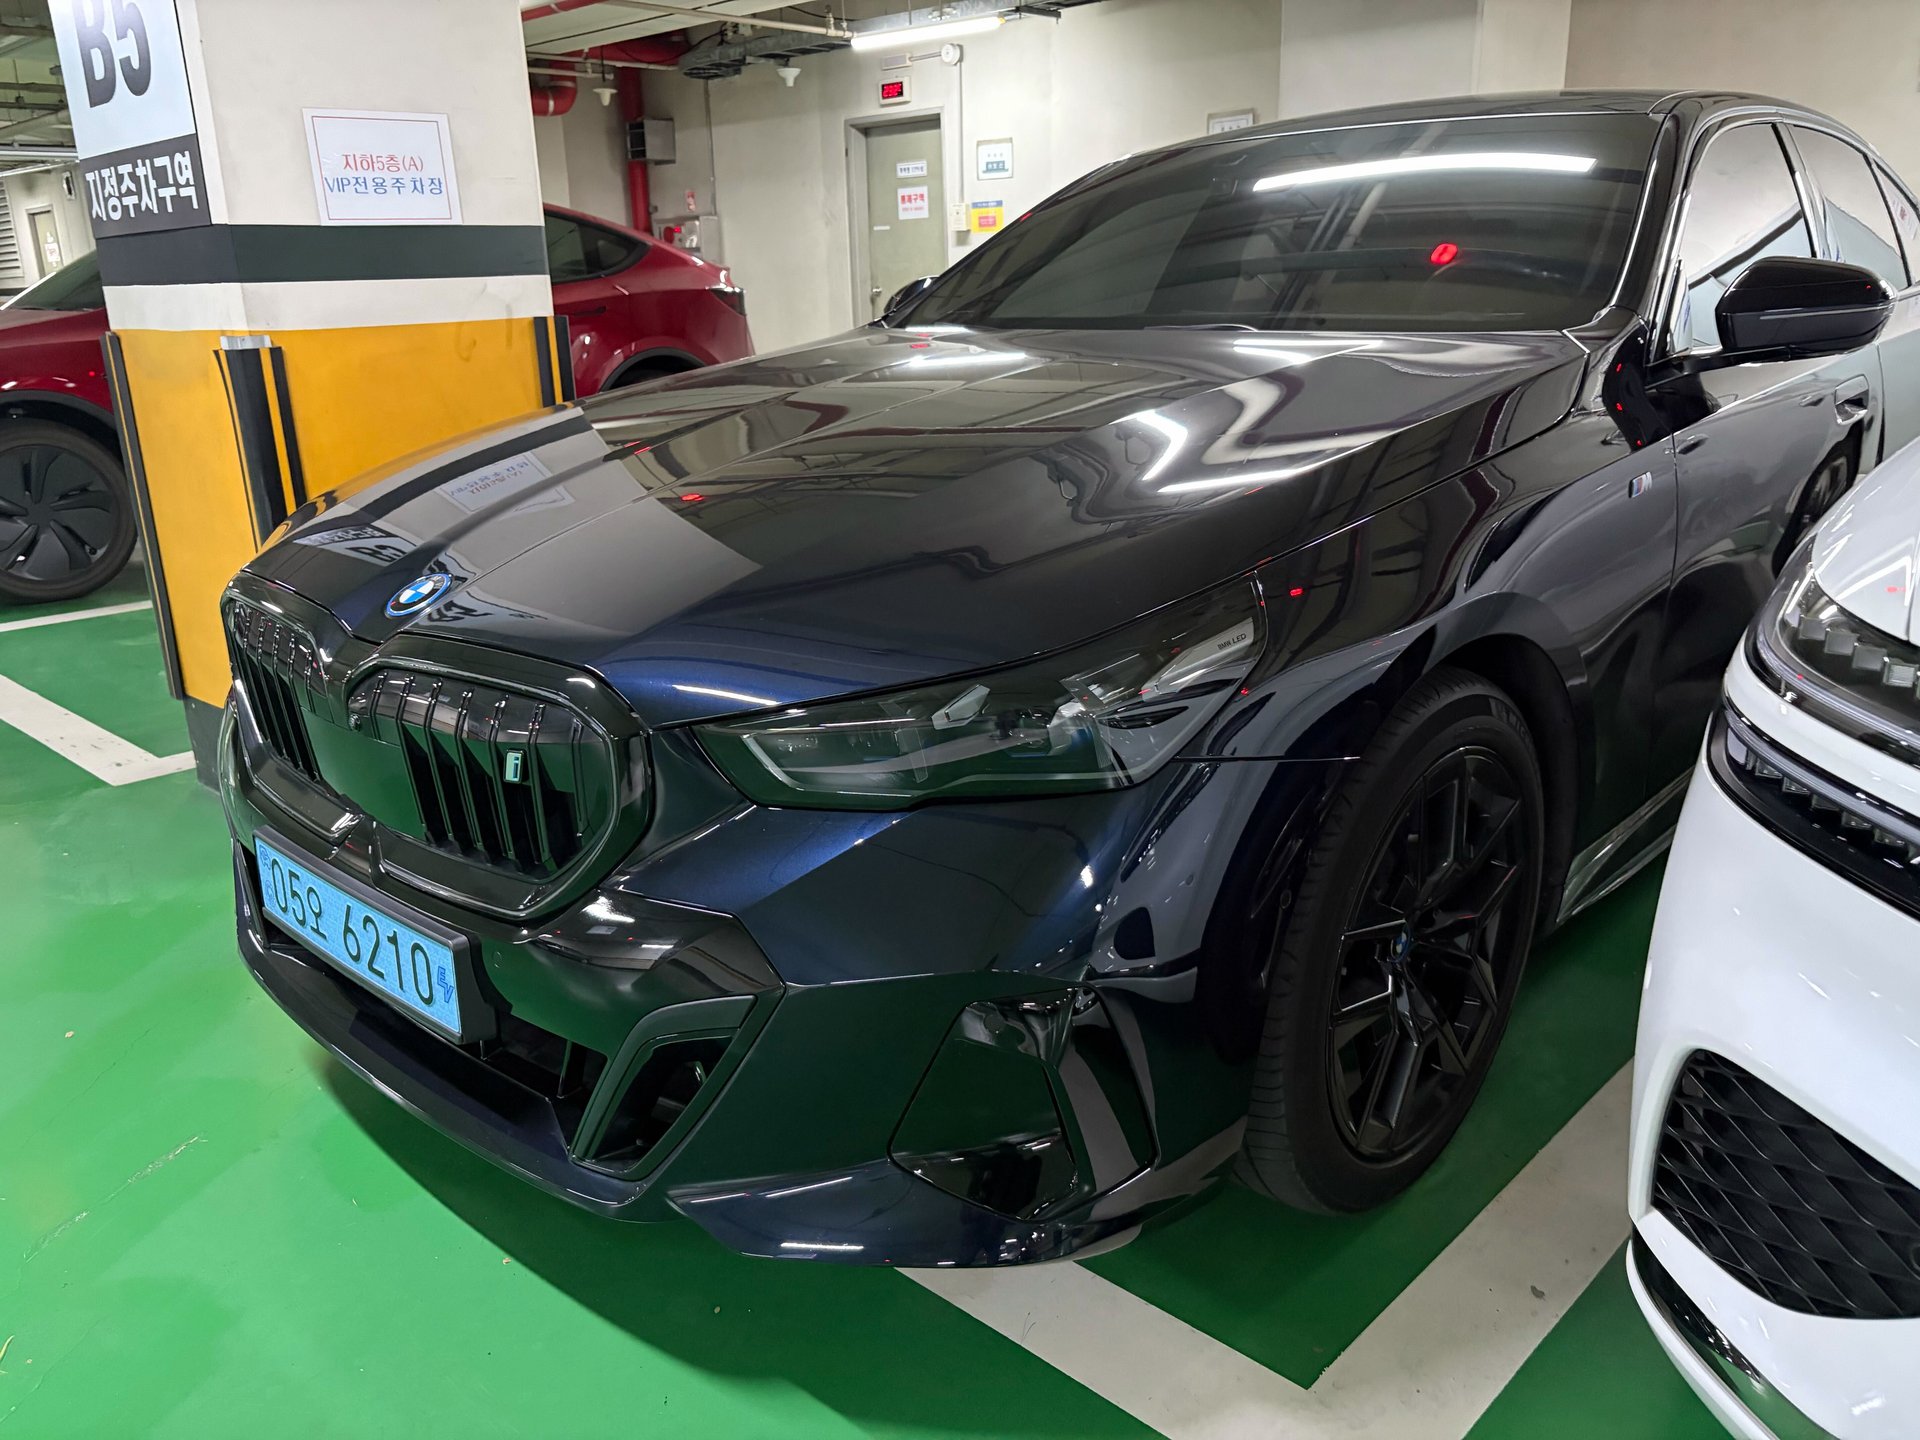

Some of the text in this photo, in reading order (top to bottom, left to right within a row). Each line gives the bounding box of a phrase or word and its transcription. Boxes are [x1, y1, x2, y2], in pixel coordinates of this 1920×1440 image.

[72, 0, 152, 109] B5
[342, 153, 424, 173] 지하5층(A)
[85, 150, 199, 222] 지정주차구역
[324, 176, 444, 195] VIP전용주차장
[1232, 633, 1247, 644] LED
[271, 858, 434, 1006] 05오 6210
[437, 965, 454, 1004] EV
